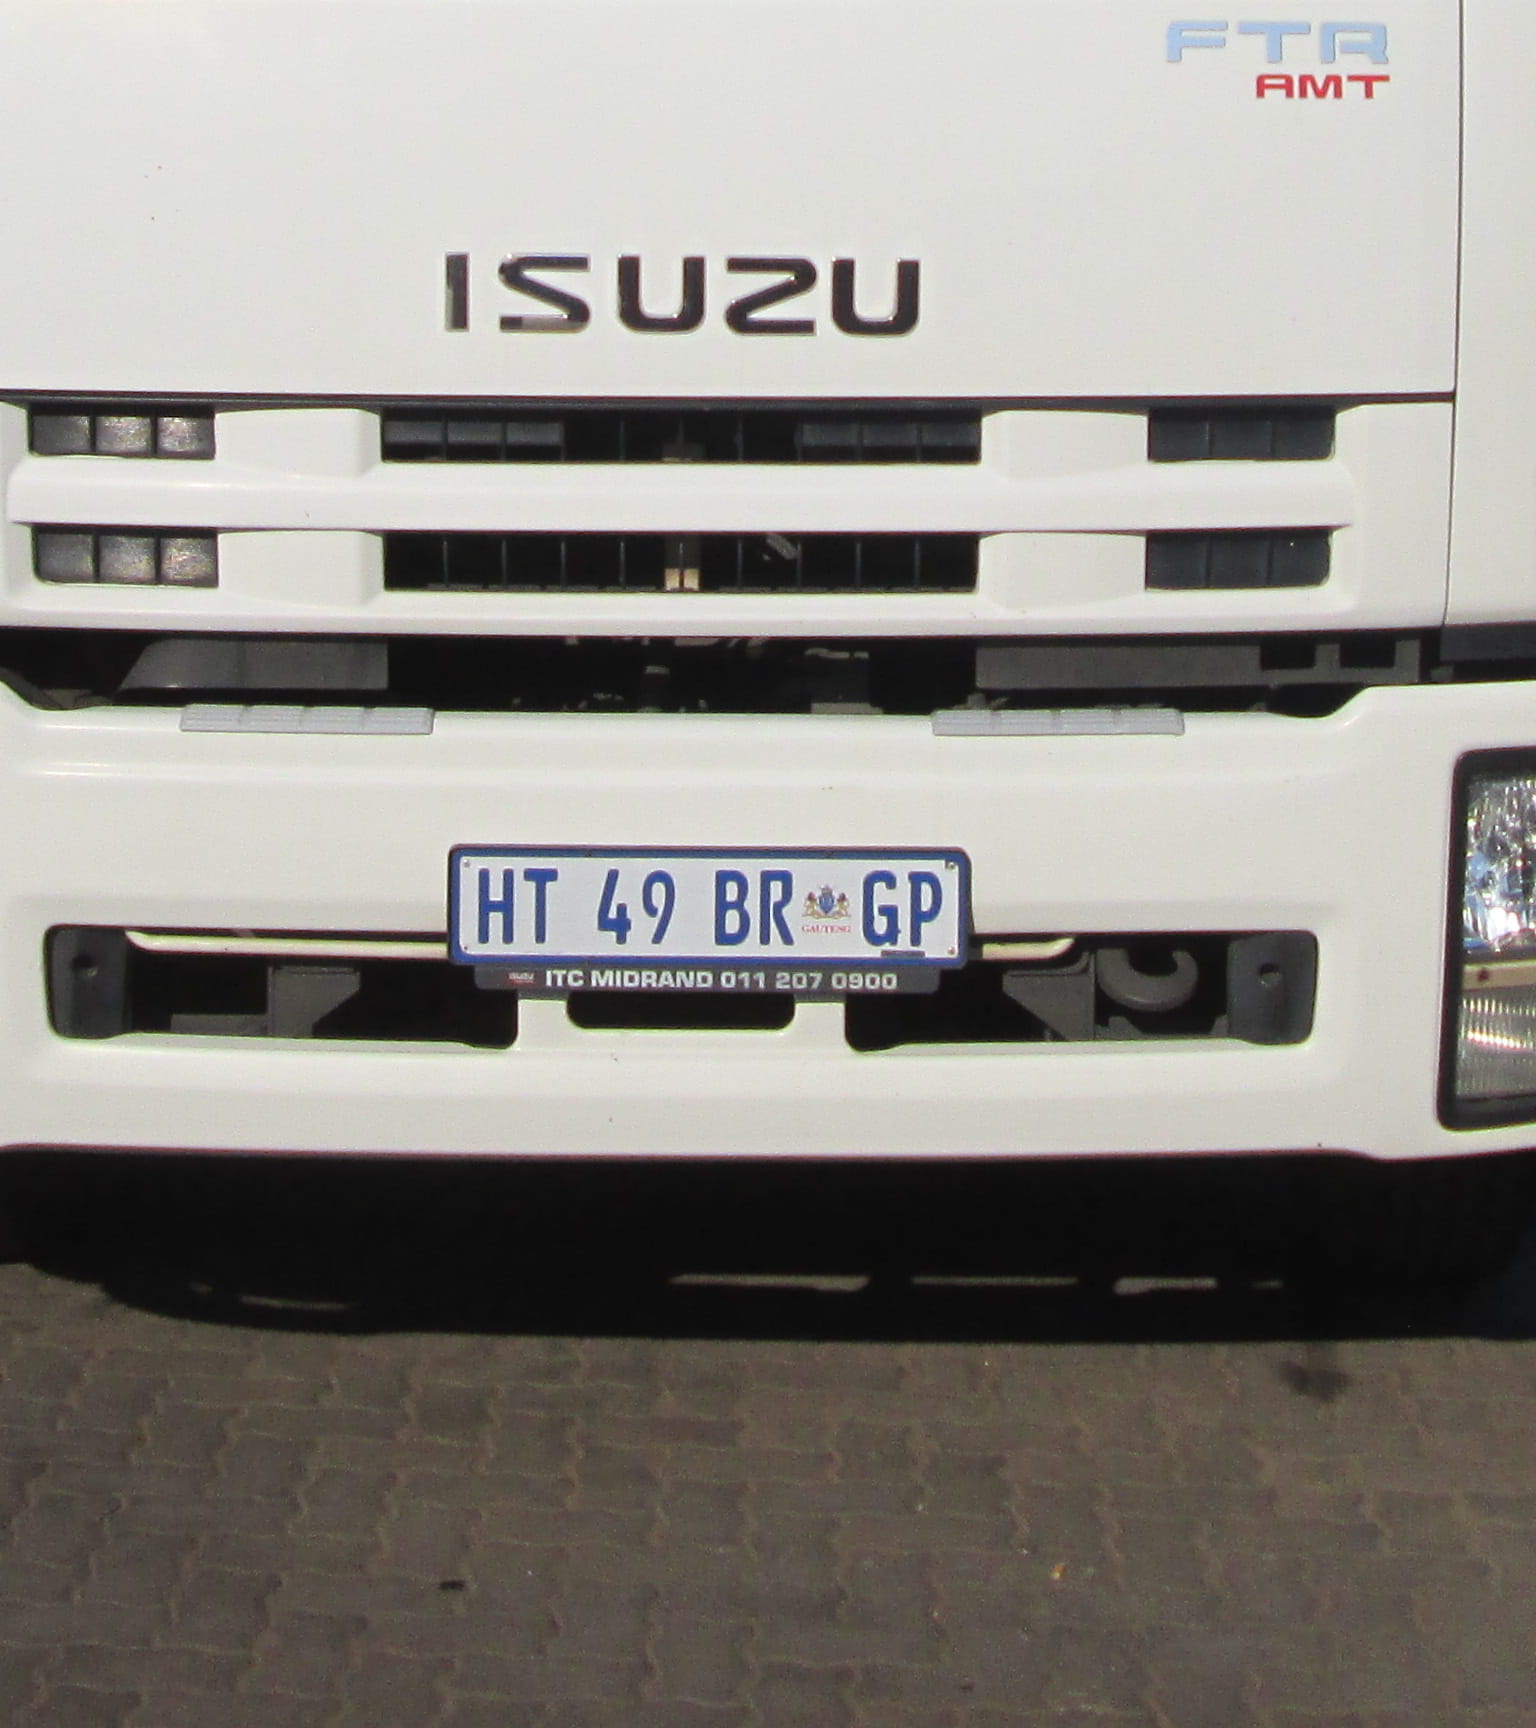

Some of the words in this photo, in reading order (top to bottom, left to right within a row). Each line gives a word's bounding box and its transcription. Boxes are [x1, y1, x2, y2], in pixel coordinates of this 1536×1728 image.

[1166, 20, 1389, 64] FTR
[1255, 73, 1390, 99] AMT
[444, 251, 921, 337] ISUZU
[477, 867, 558, 945] HT
[596, 868, 676, 946] 49
[714, 869, 795, 947] BR
[862, 870, 944, 947] GP
[801, 924, 852, 934] GAUTENG
[545, 969, 585, 988] ITC
[590, 969, 714, 989] MIDRAND
[720, 971, 766, 989] 011
[775, 971, 823, 990] 207
[831, 972, 898, 990] 0900
